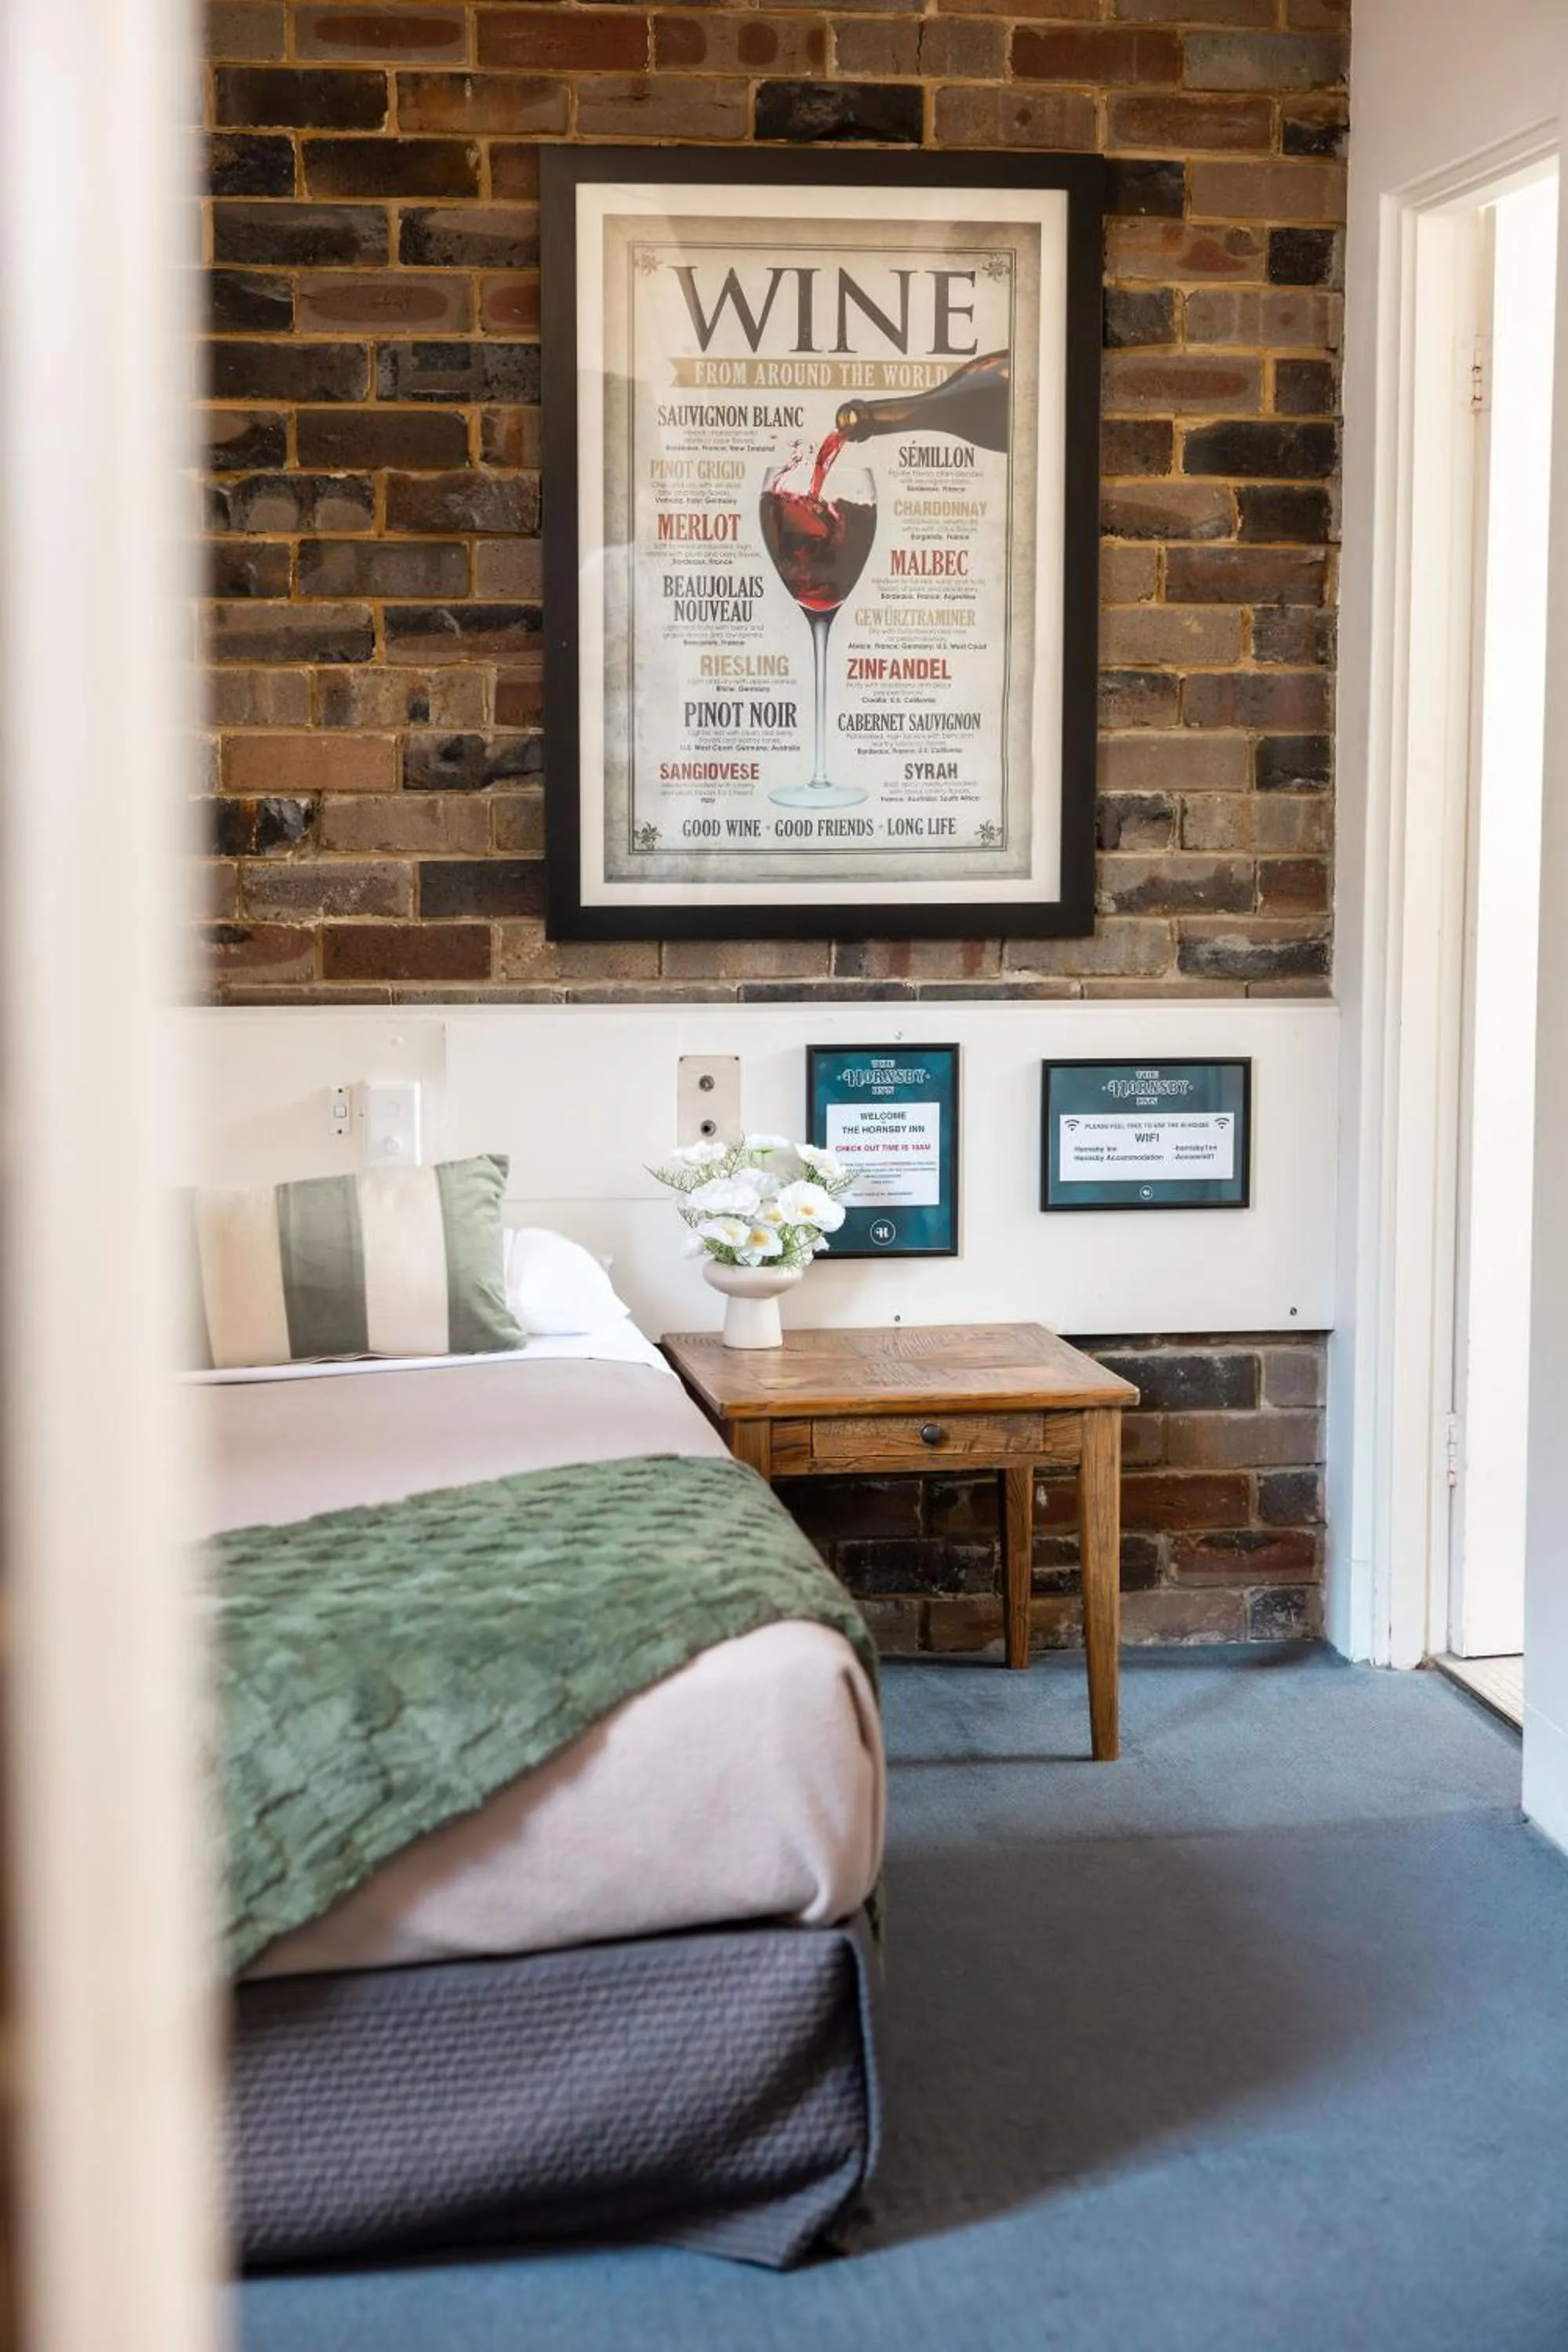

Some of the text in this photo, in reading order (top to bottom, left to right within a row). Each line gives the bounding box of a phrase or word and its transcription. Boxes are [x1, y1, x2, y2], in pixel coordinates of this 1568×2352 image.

[666, 265, 978, 354] WINE
[695, 361, 948, 387] FROM AROUND THE WORLD
[658, 405, 804, 427] SAUVIGNON BLANC
[898, 441, 975, 467] SÉMILLON
[650, 459, 745, 479] PINOT GRIGIO
[894, 500, 987, 517] CHARDONNAY
[658, 514, 741, 541] MERLOT
[891, 550, 968, 576] MALBEC
[663, 575, 764, 598] BEAUJOLAIS
[673, 601, 753, 622] NOUVEAU
[855, 604, 975, 626] GEWÜRZTRAMINER
[700, 655, 789, 677] RIESLING
[847, 659, 952, 680] ZINFANDEL
[684, 702, 797, 728] PINOT NOIR
[838, 713, 982, 731] CABERNET SAUVIGNON
[660, 763, 760, 780] SANGIOVESE
[905, 763, 958, 779] SYRAH
[683, 818, 956, 837] GOOD WINE GOOD FRIENDS LONG LIFE
[842, 1069, 926, 1087] HORNSBY
[1107, 1080, 1189, 1098] HORNSBY
[842, 1126, 859, 1134] THE
[862, 1125, 907, 1134] HORNSBY
[1134, 1133, 1160, 1142] WIFI
